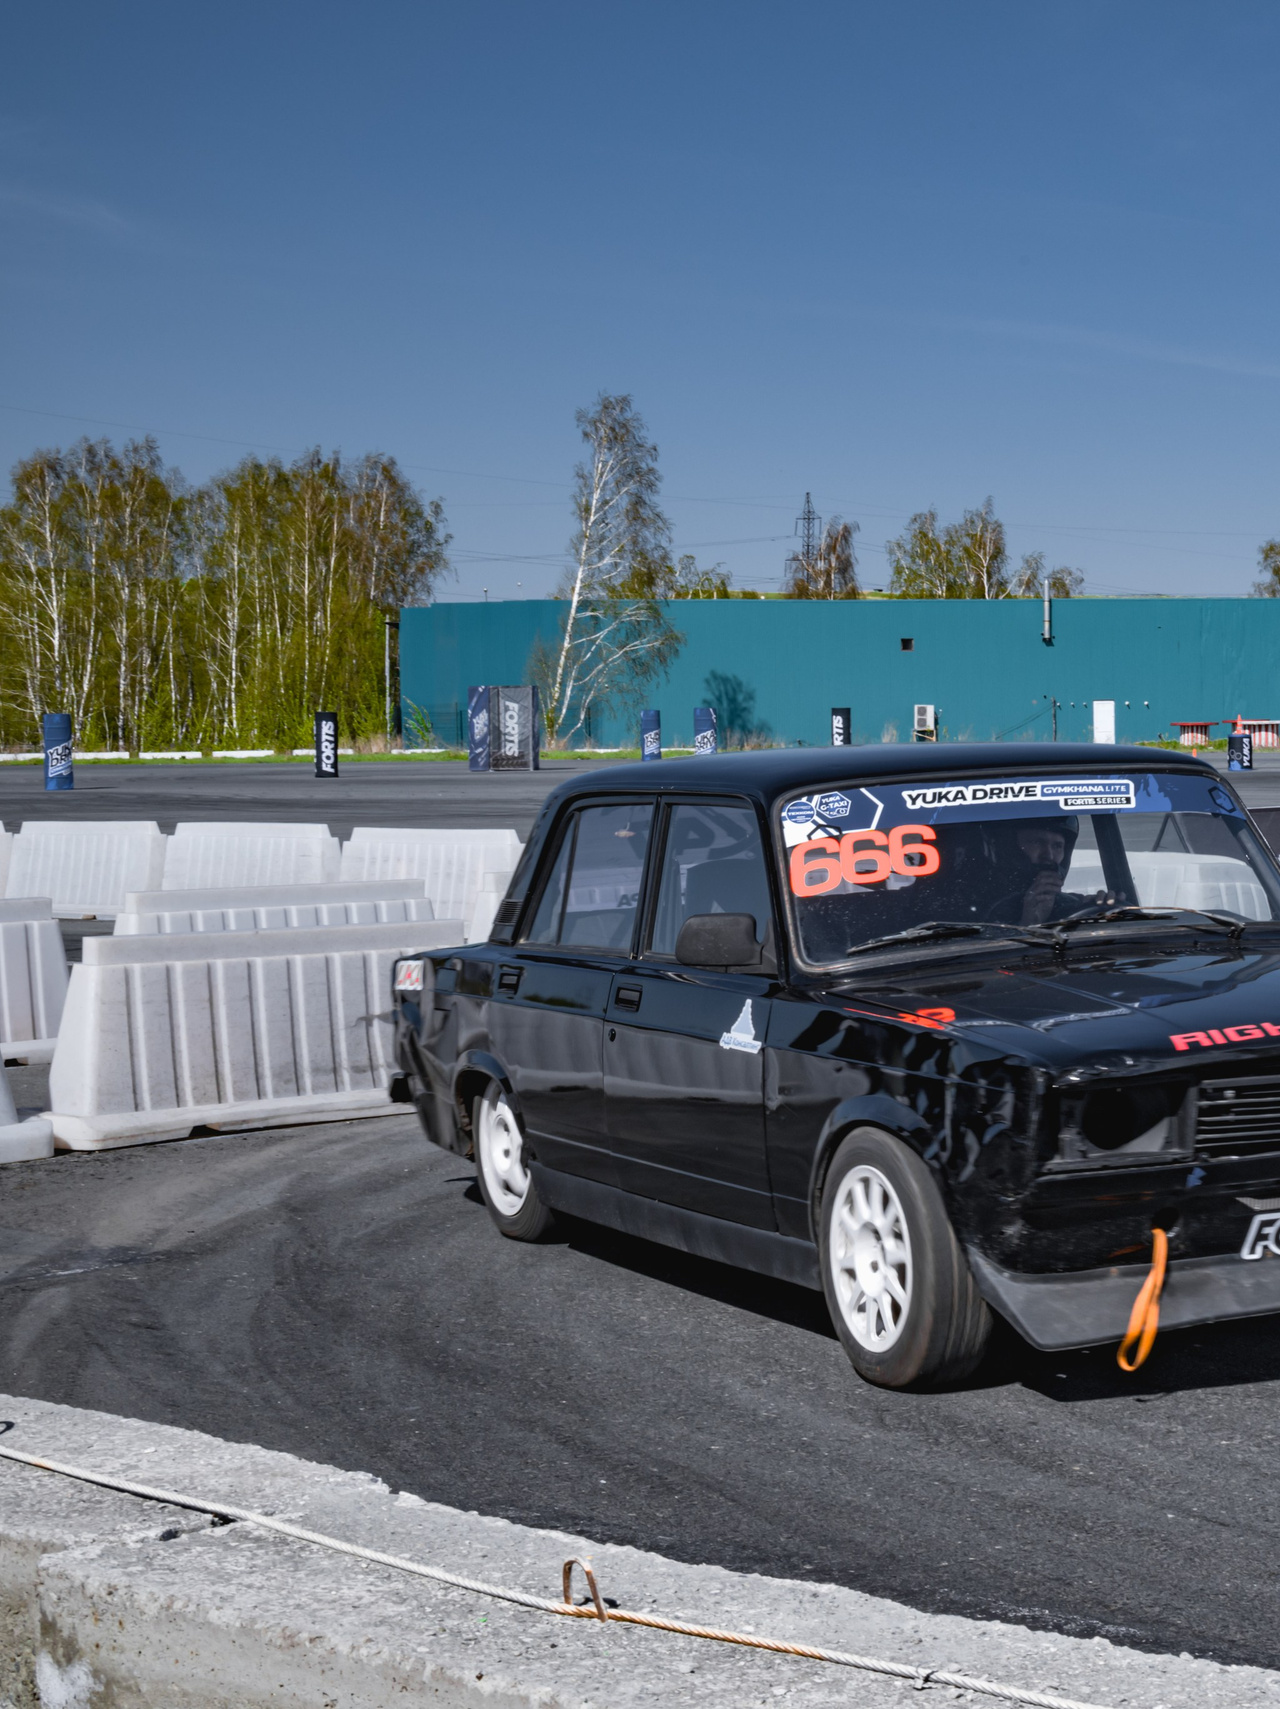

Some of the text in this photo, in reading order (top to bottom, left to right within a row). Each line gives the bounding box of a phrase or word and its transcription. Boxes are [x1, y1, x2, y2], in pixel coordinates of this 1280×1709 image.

[321, 720, 335, 773] FORTIS
[505, 701, 519, 757] FORTIS
[833, 715, 844, 746] RTIS
[907, 785, 1038, 806] YUKA DRIVE
[1043, 785, 1105, 794] GYMKHANA
[790, 824, 941, 898] 666
